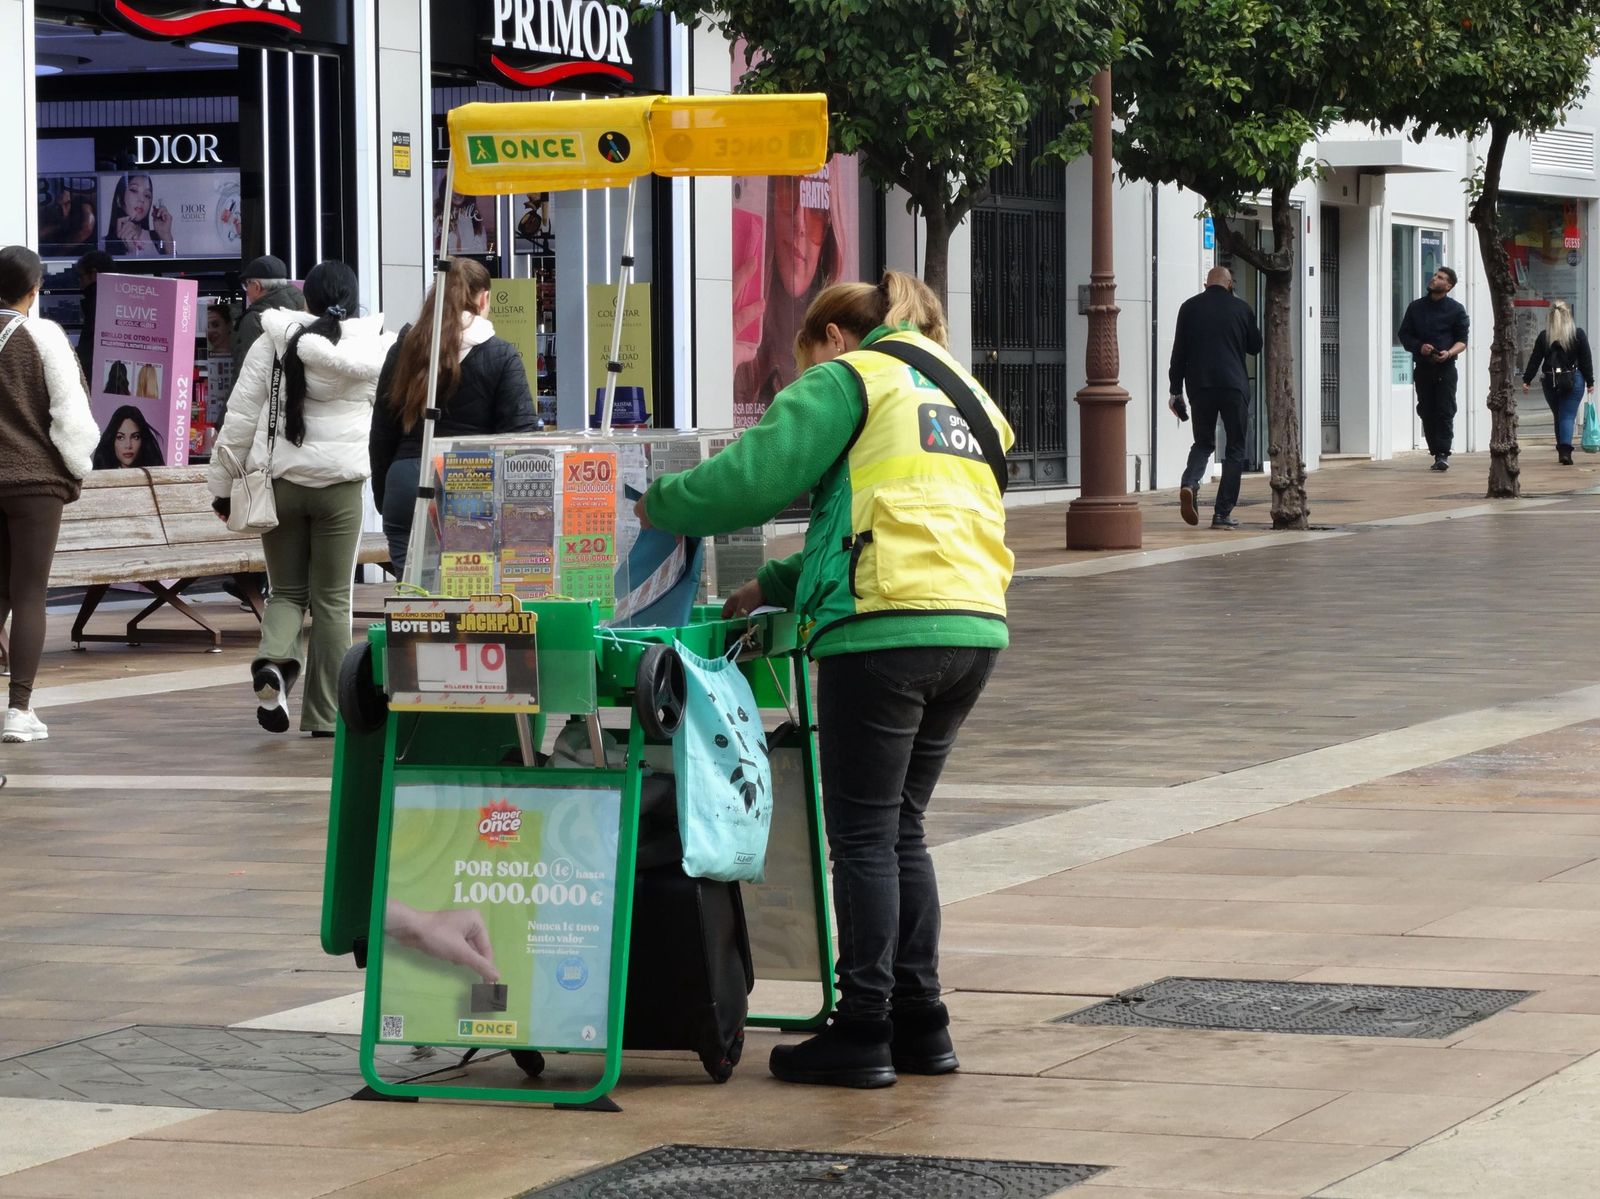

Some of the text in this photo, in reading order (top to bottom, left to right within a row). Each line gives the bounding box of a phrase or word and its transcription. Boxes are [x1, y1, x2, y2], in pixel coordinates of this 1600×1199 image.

[492, 0, 633, 65] PRIMOR
[134, 133, 222, 164] DIOR
[501, 138, 576, 159] ONCE
[799, 180, 830, 210] GRATIS
[181, 203, 206, 214] DIOR
[1564, 237, 1580, 249] GUESS
[115, 304, 158, 321] ELVIVE
[133, 334, 151, 343] OTRO
[746, 402, 754, 414] DE
[755, 402, 766, 414] LAS
[950, 429, 983, 455] ON
[505, 460, 553, 473] 1000000€
[391, 613, 531, 633] BOTE DE JACKPOT
[454, 860, 605, 880] POR SOLO 1€ hasta
[527, 920, 561, 932] Nunca
[576, 923, 600, 933] tuvo
[527, 932, 584, 944] tanto valor
[475, 1023, 513, 1035] ONCE
